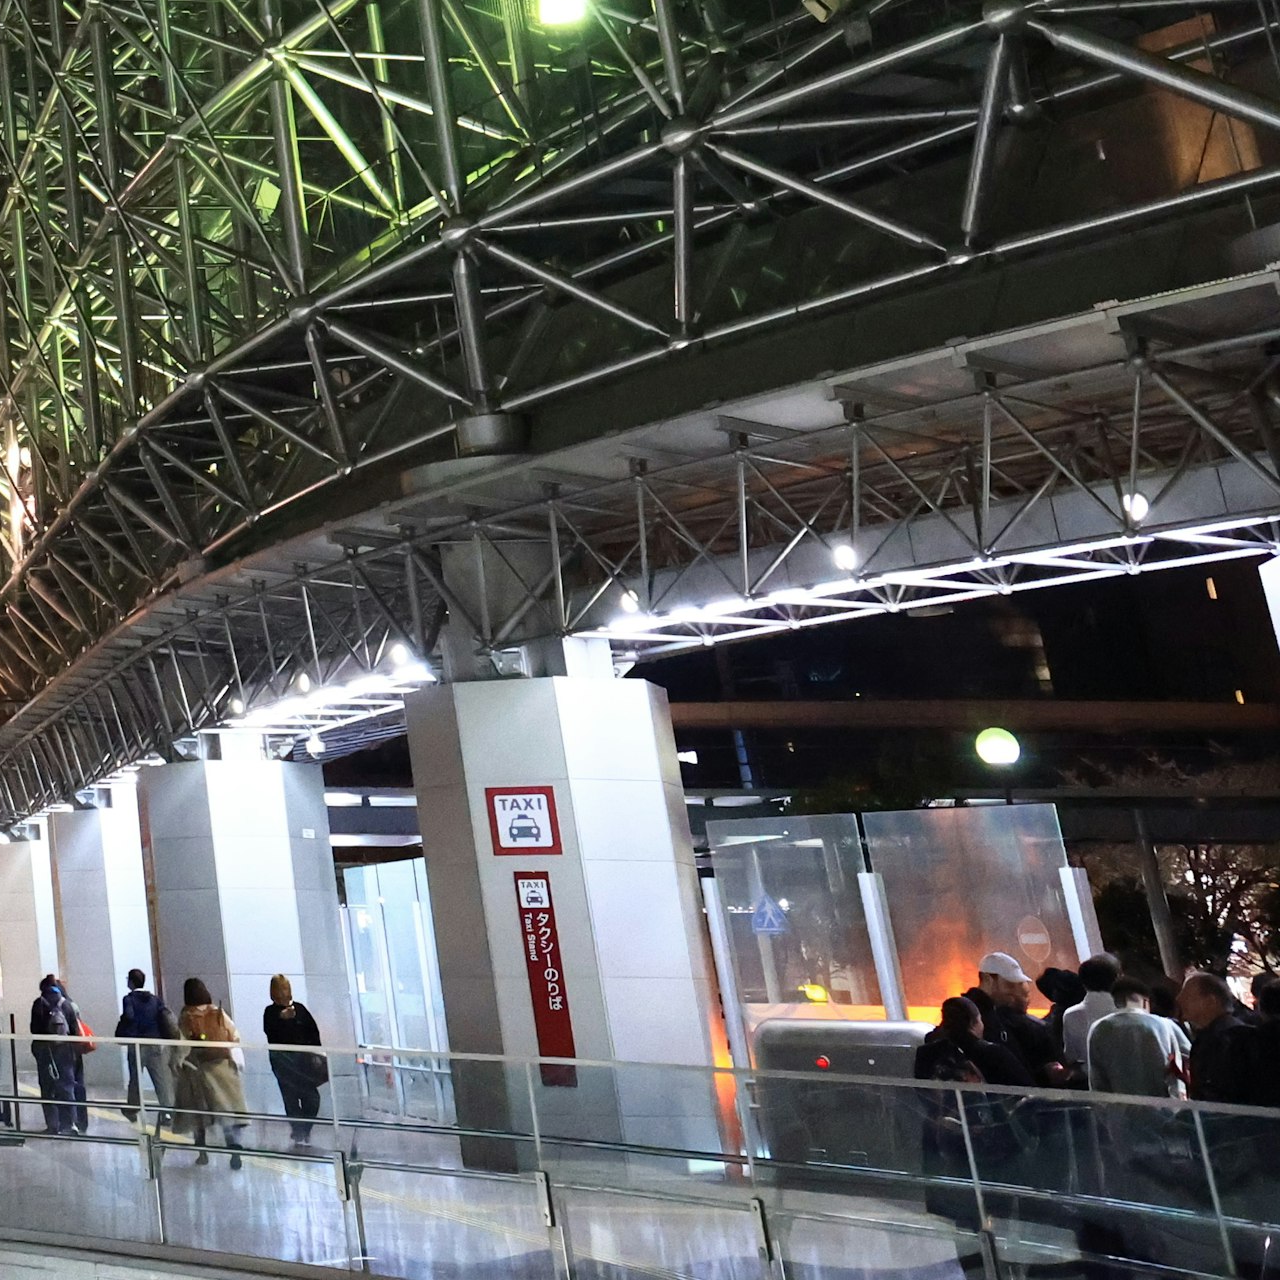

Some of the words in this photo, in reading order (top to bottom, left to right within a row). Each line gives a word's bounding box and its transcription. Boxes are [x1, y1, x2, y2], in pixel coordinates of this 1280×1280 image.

[498, 798, 543, 812] TAXI
[520, 880, 545, 889] TAXI
[524, 913, 534, 932] Taxi
[527, 934, 539, 962] Stand
[536, 912, 563, 1011] タクシーのりば
